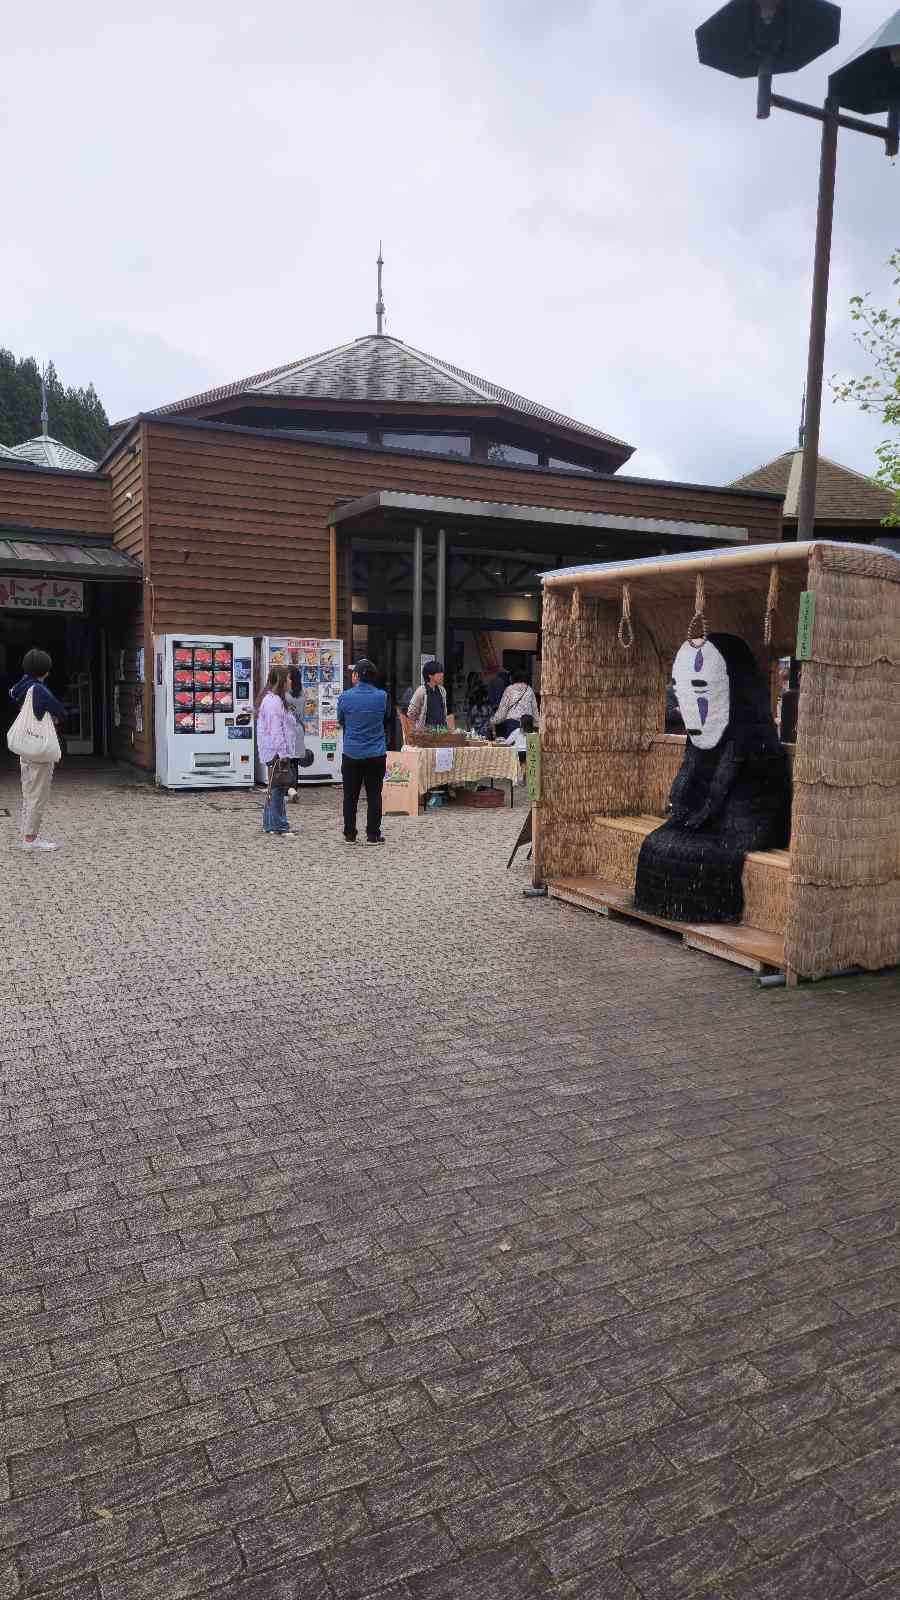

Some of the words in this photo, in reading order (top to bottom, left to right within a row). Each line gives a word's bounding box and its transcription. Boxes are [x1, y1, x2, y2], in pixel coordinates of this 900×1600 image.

[9, 580, 71, 600] トイレ
[12, 597, 66, 609] TOILET
